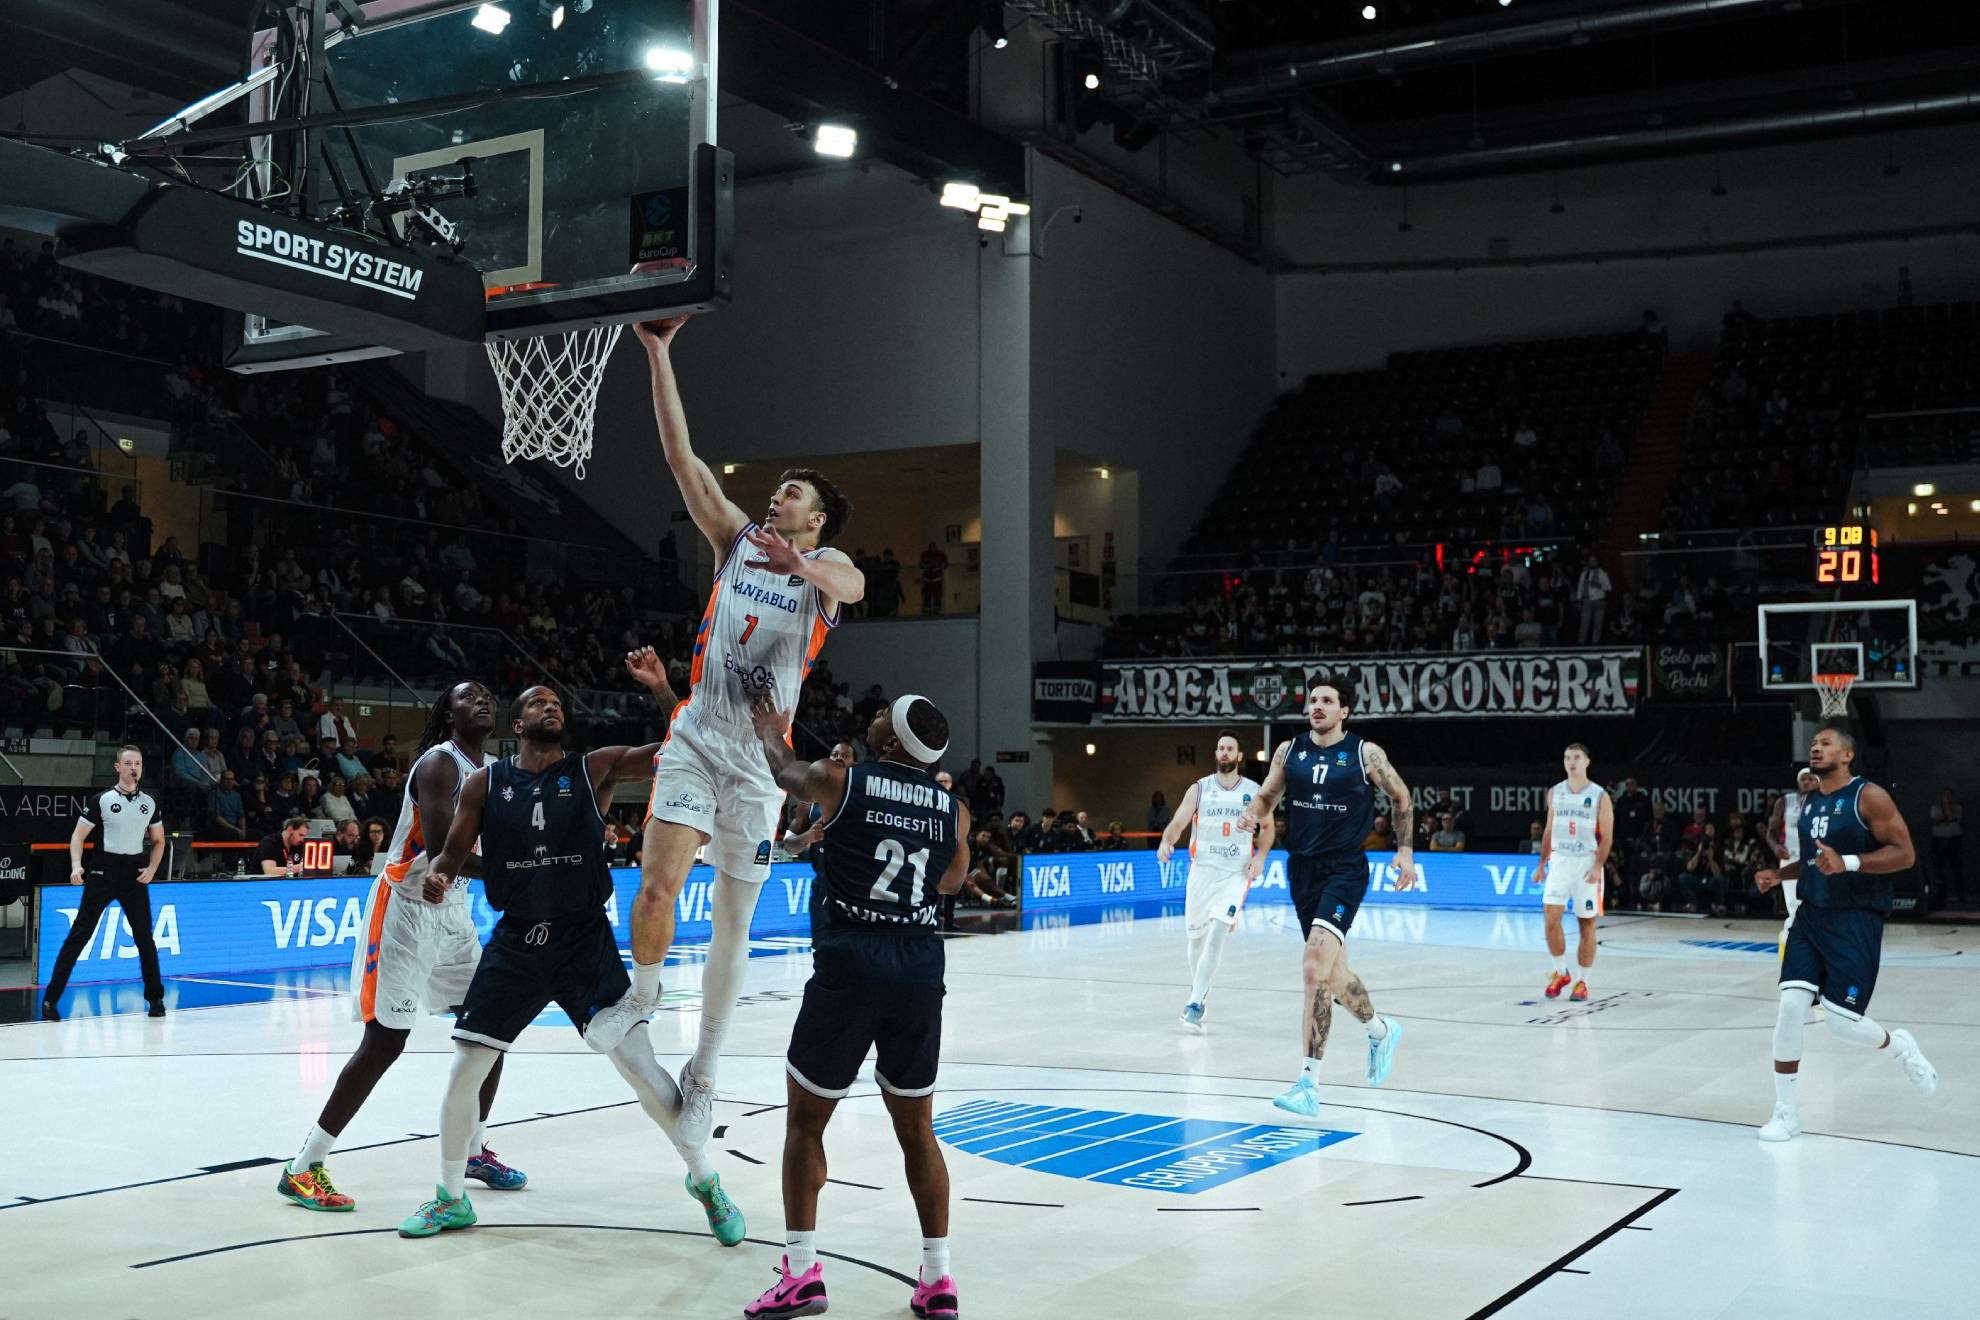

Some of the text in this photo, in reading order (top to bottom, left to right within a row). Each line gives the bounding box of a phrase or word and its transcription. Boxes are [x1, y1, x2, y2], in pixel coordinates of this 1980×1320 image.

[238, 219, 424, 292] SPORT SYSTEM
[1818, 552, 1860, 582] 20
[738, 614, 759, 645] 7
[1659, 647, 1717, 672] Solo per
[1113, 666, 1235, 717] AREA
[1312, 764, 1329, 785] 17
[15, 795, 88, 817] AREN
[666, 801, 701, 812] LEXUS
[865, 775, 951, 814] MADDOX JR
[1292, 799, 1348, 812] BAGLIETTO
[531, 802, 546, 831] 4
[866, 810, 927, 833] ECOGEST
[1810, 816, 1829, 839] 35
[304, 841, 333, 870] 00
[506, 854, 583, 870] BAGLIETTO
[869, 838, 931, 907] 21
[1027, 865, 1071, 898] VISA
[1096, 862, 1135, 893] VISA
[1157, 860, 1187, 889] VIS
[779, 878, 812, 916] VI
[260, 896, 362, 949] VISA
[1121, 1127, 1332, 1189] GRUPPO ASTM
